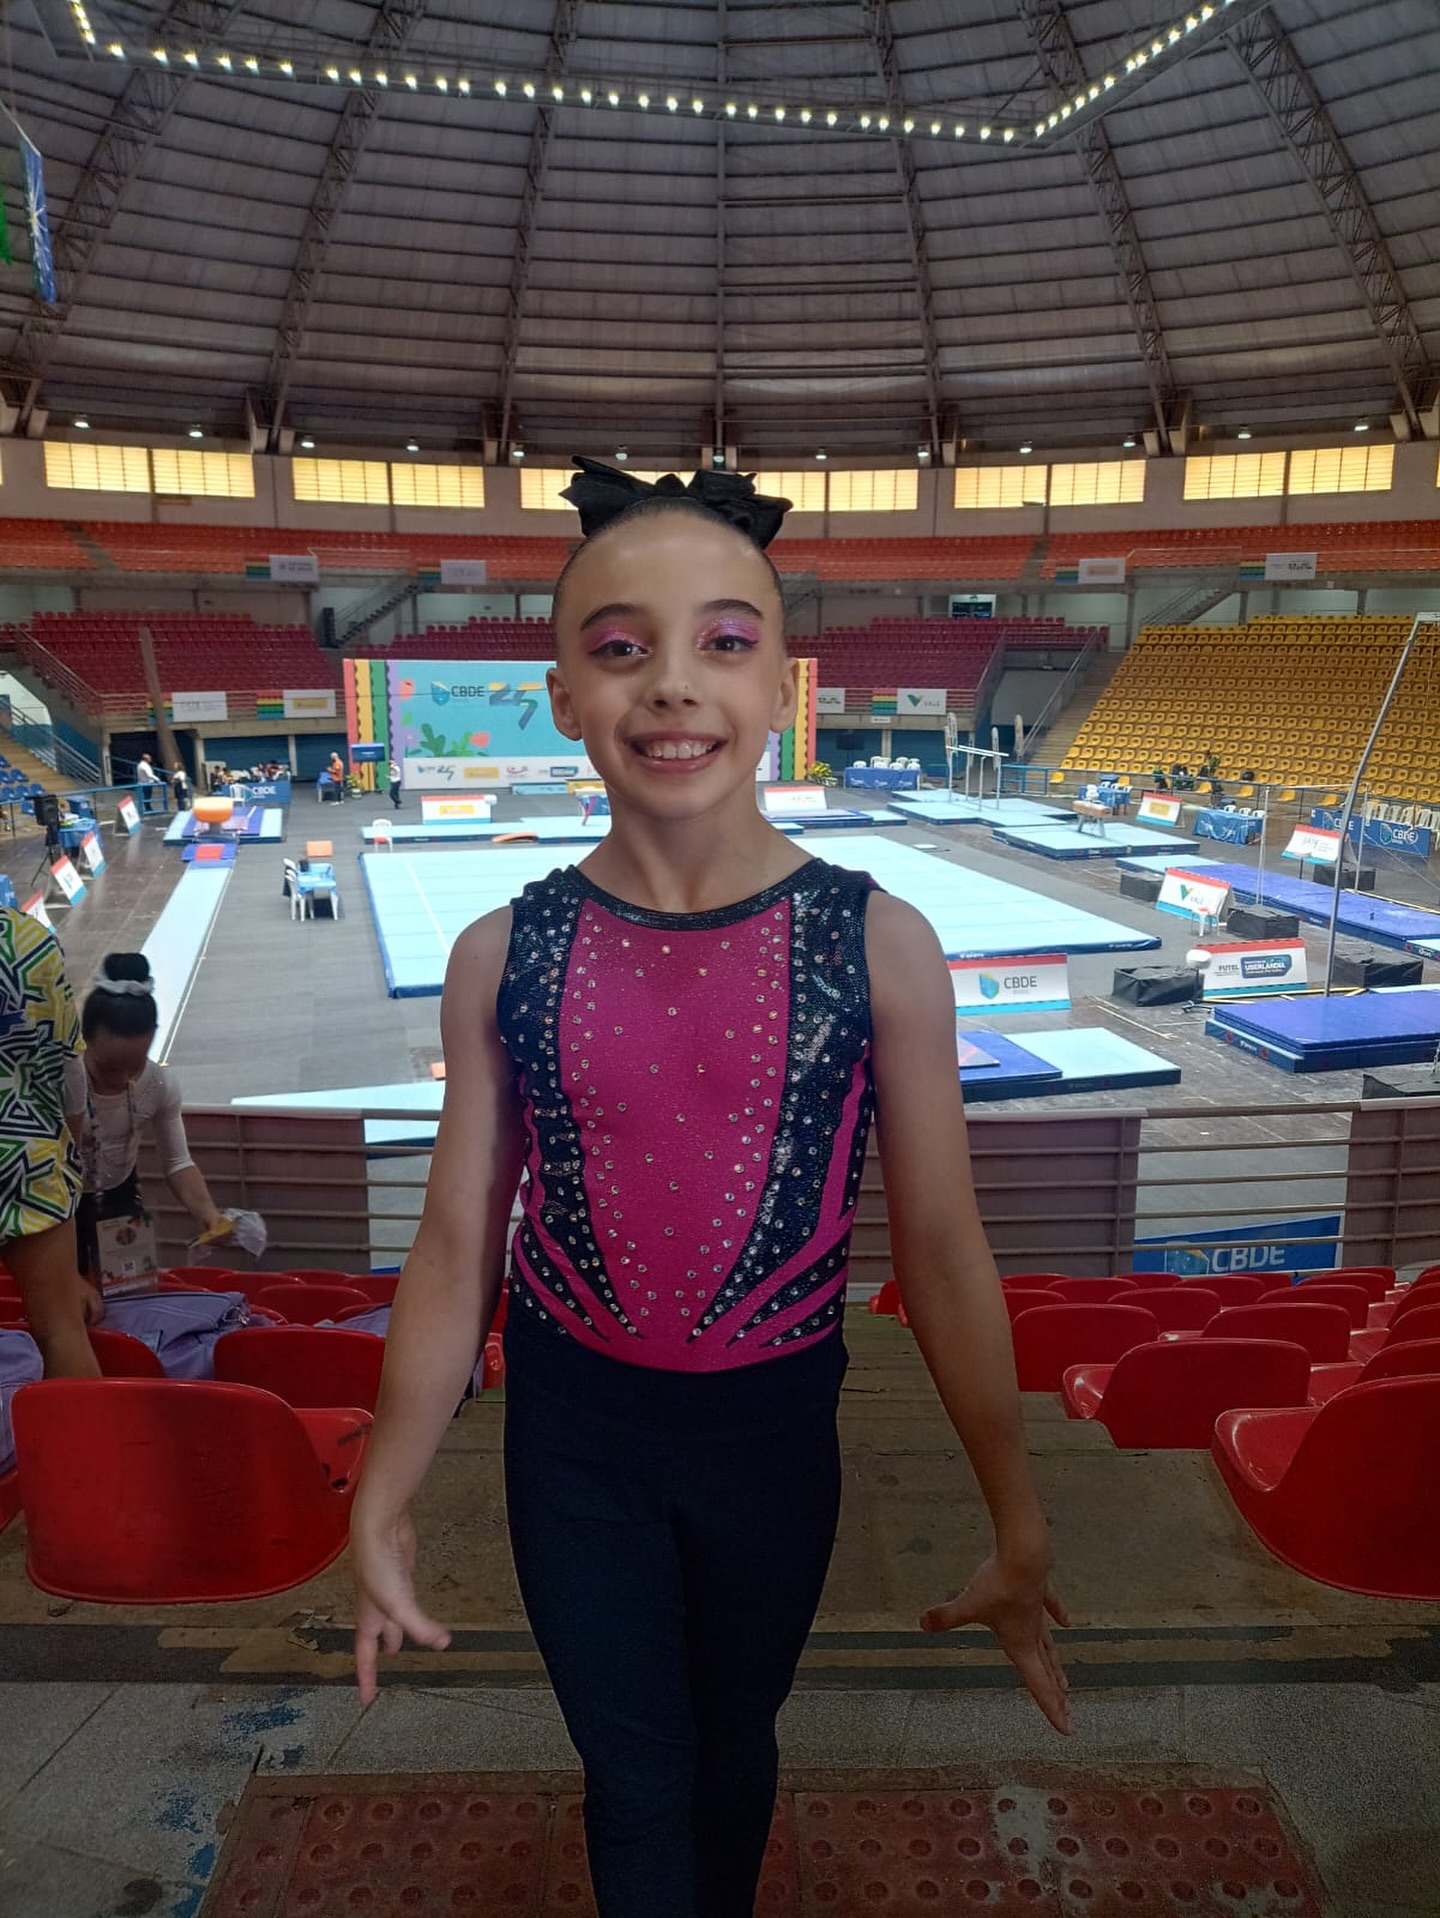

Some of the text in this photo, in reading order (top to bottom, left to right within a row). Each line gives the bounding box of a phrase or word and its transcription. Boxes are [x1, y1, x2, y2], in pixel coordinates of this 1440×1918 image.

[451, 686, 485, 697] CBDE
[1004, 976, 1037, 989] CBDE
[1211, 1246, 1285, 1273] CBDE
